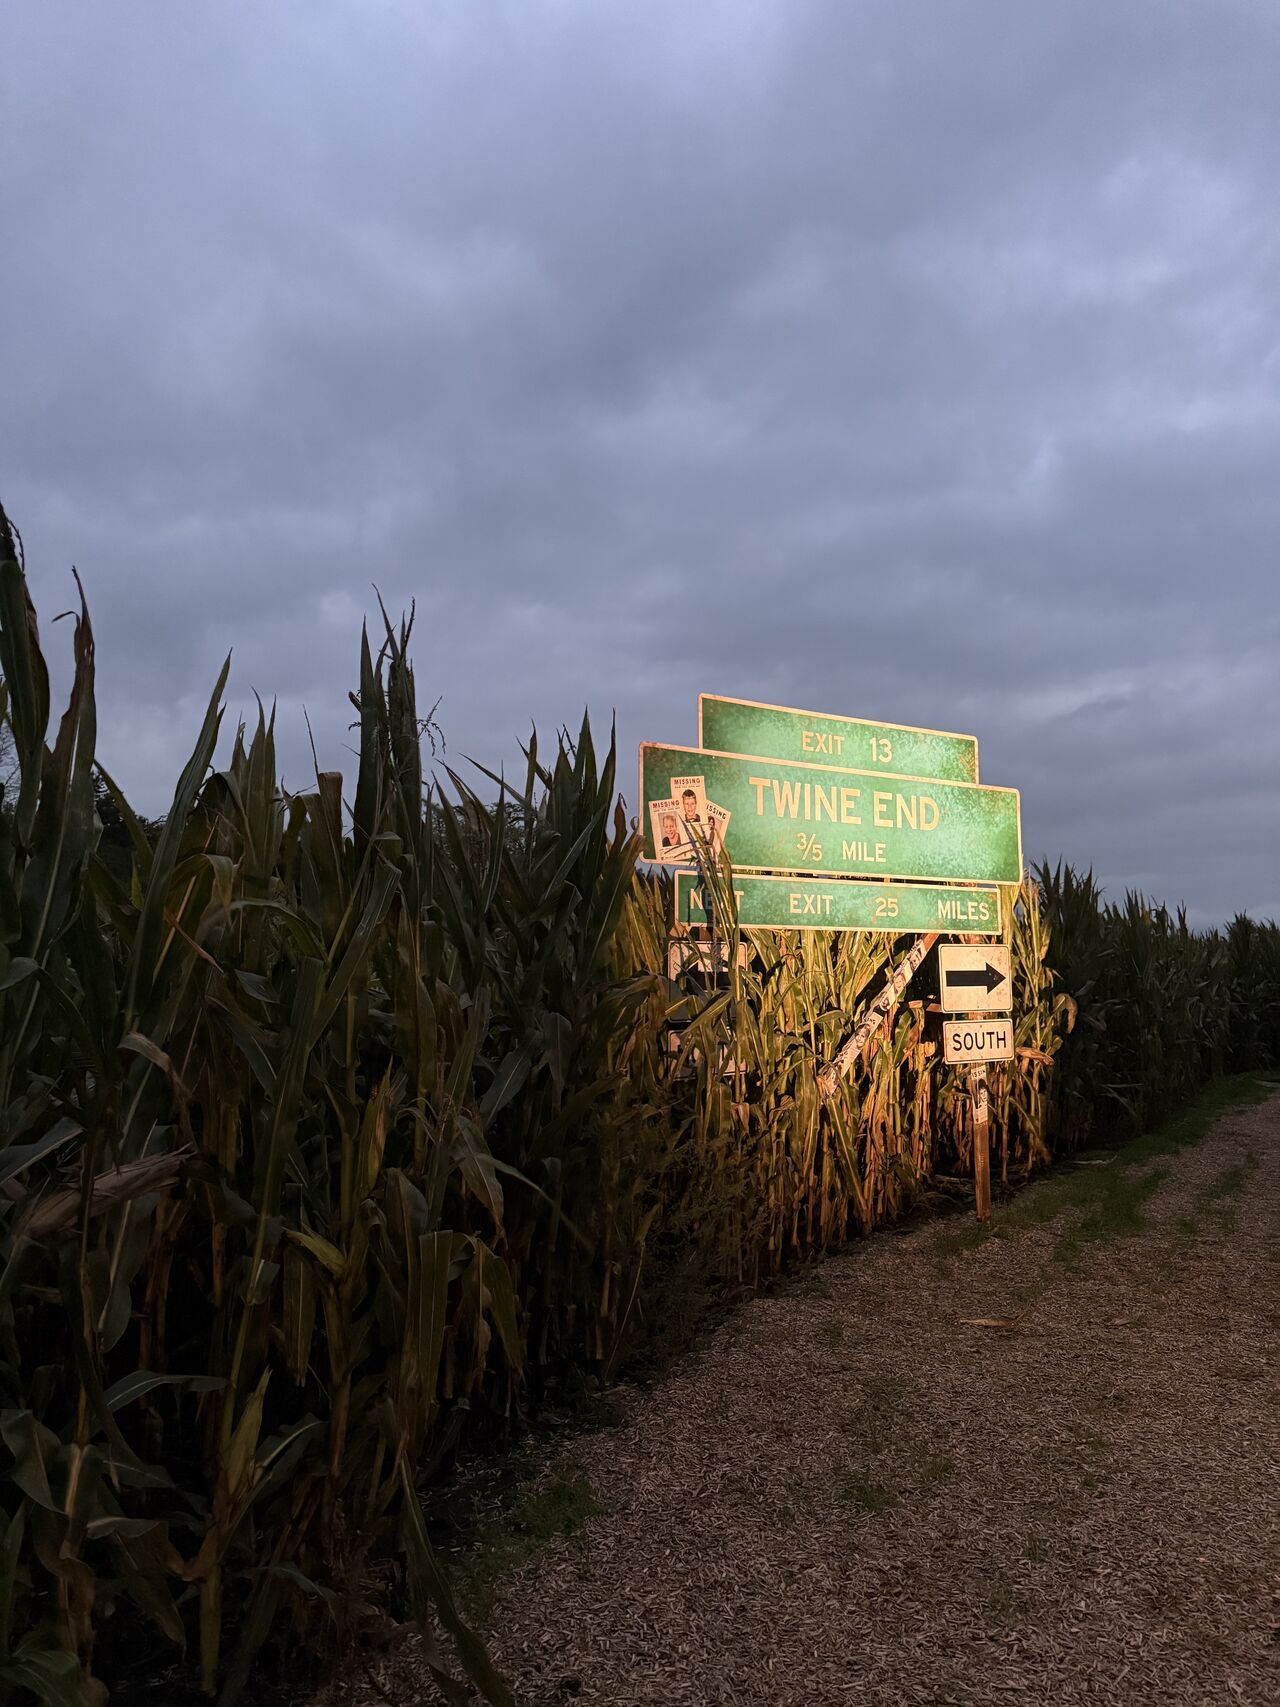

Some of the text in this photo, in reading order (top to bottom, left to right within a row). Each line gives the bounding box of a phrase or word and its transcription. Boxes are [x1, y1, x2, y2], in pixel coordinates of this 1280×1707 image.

[802, 731, 893, 763] EXIT 13
[652, 800, 680, 809] MISSING
[706, 804, 727, 820] ISSING
[749, 777, 940, 832] TWINE END
[842, 840, 887, 862] MILE
[689, 888, 990, 921] NET EXIT 25 MILES
[952, 1031, 1007, 1052] SOUTH
